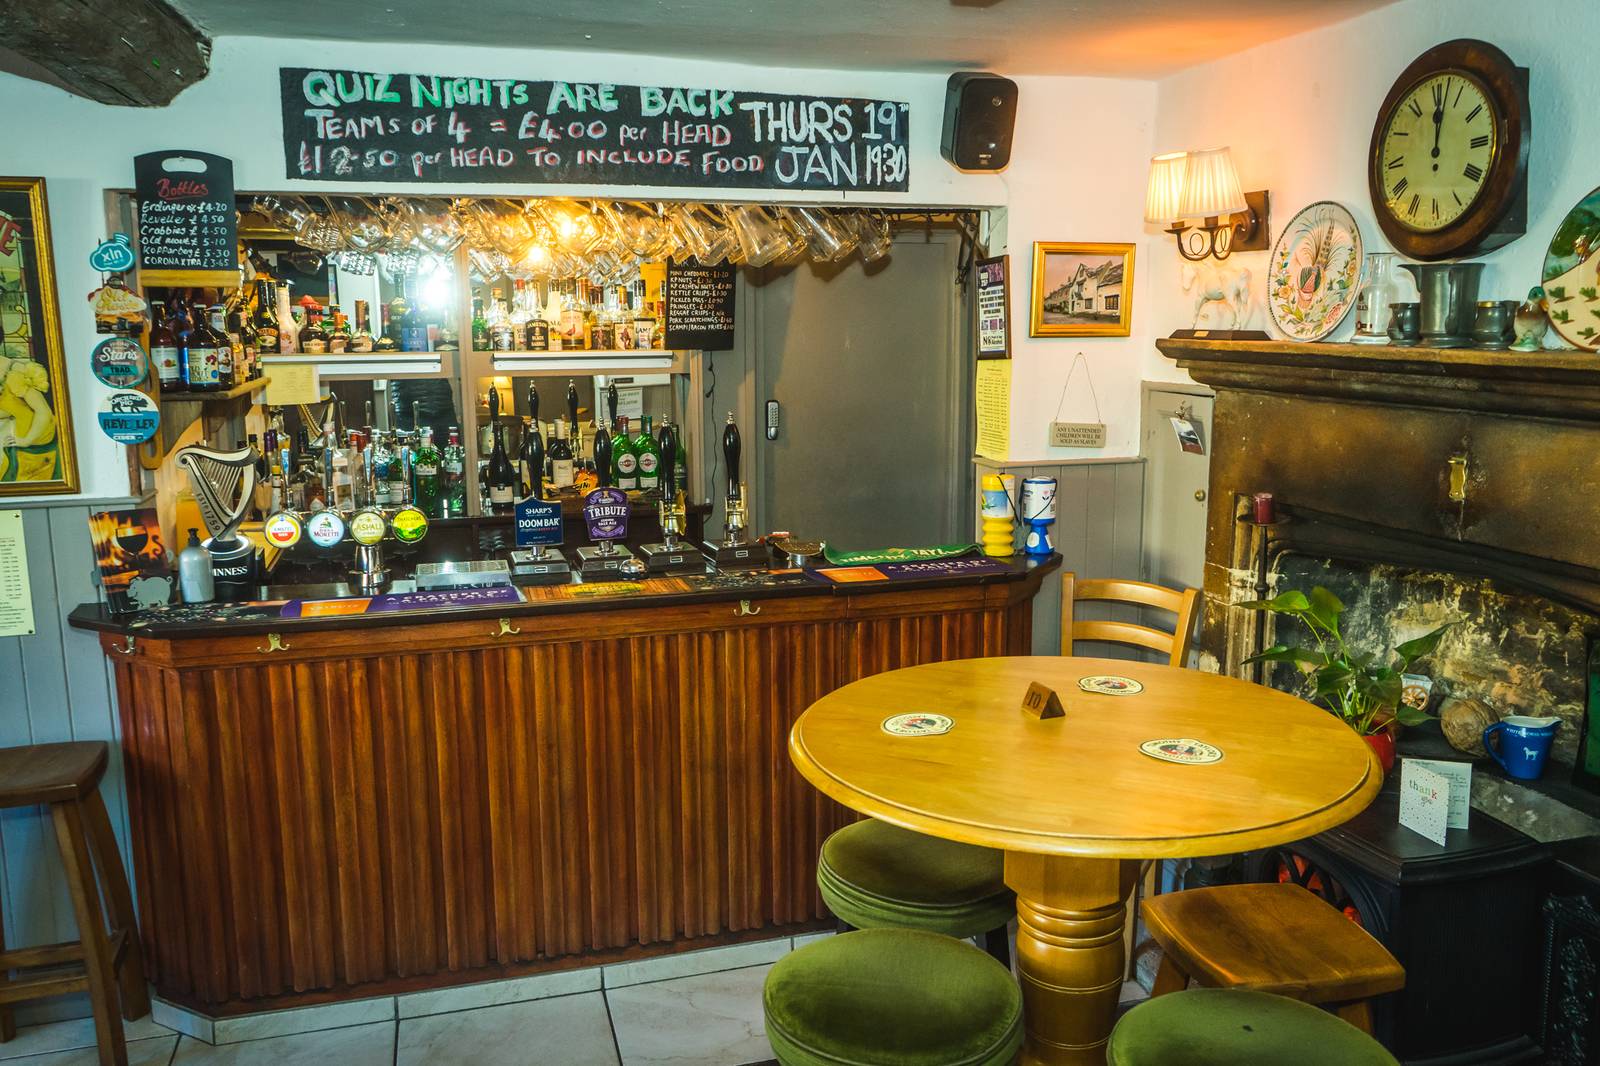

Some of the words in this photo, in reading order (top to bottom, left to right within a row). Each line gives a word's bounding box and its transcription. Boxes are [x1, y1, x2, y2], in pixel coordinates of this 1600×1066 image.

[303, 71, 400, 107] QUIZ
[409, 73, 528, 109] NIGHTS
[546, 80, 619, 114] ARE
[640, 86, 735, 118] BACK
[304, 109, 400, 140] TEAMS
[448, 111, 471, 144] 4
[619, 125, 647, 147] per
[662, 120, 732, 147] HEAD
[739, 101, 853, 143] THURS
[411, 151, 442, 177] per
[450, 147, 514, 168] HEAD
[527, 147, 561, 167] TO
[577, 148, 691, 168] INCLUDE
[701, 151, 764, 176] FOOD
[774, 142, 857, 187] JAN
[156, 178, 209, 197] Bottles
[144, 257, 179, 265] CORONA
[525, 507, 552, 515] SHARP'S
[588, 506, 627, 518] TRIBUTE
[519, 519, 543, 528] DOOM
[544, 518, 560, 527] BAR
[212, 566, 248, 576] INNESS
[1409, 779, 1437, 800] thank
